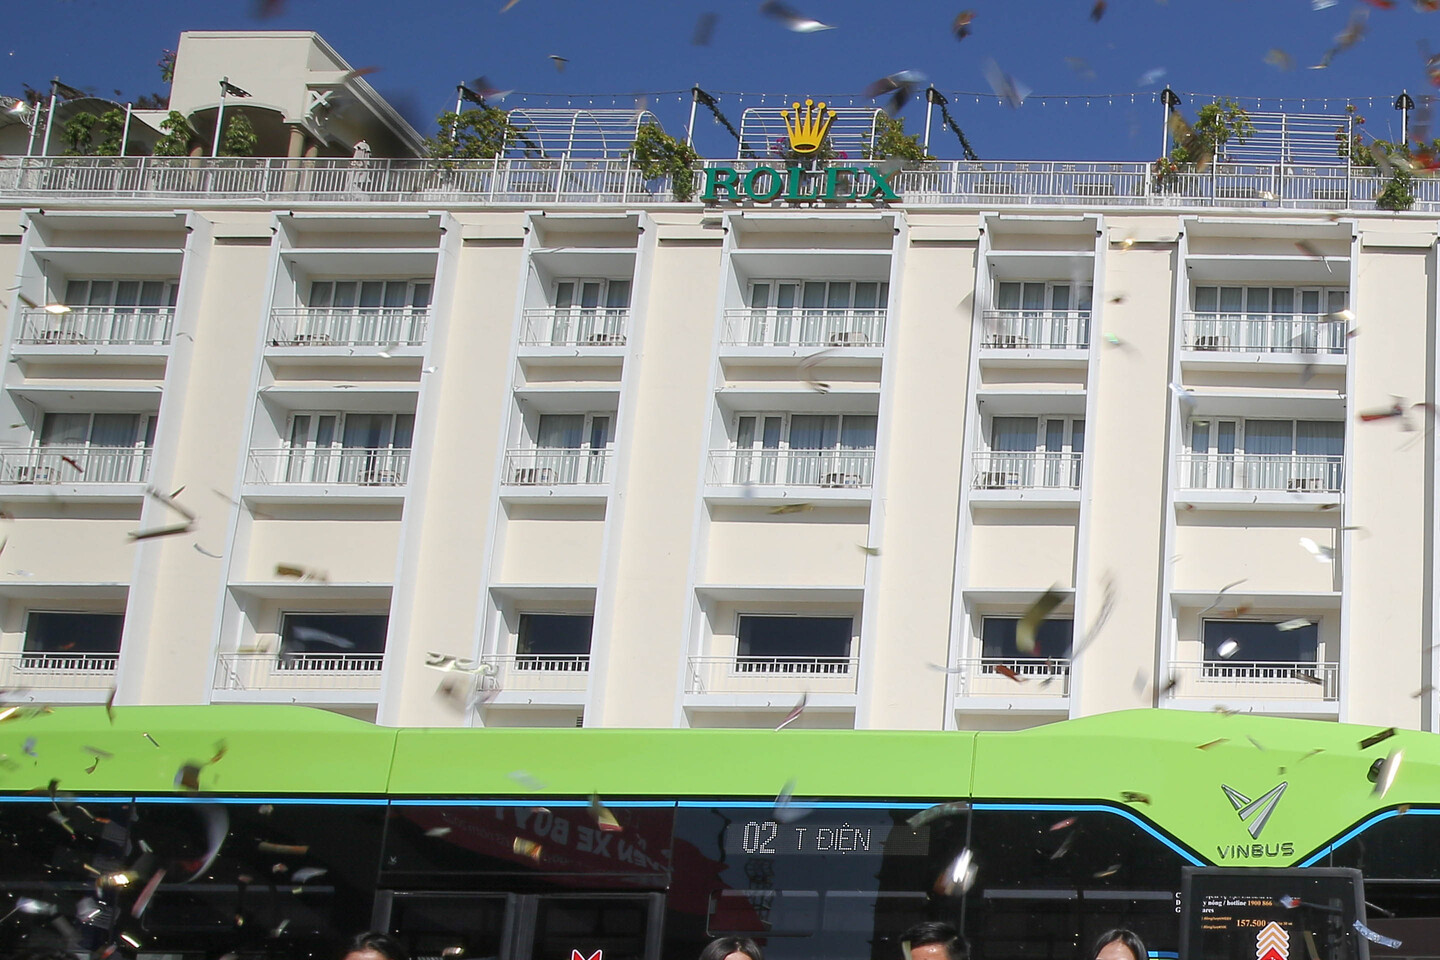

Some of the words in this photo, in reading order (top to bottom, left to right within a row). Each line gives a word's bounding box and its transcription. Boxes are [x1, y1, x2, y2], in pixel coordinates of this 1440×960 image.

[701, 165, 903, 201] ROLEX
[742, 821, 777, 854] 02
[795, 828, 807, 850] T
[816, 822, 871, 854] ĐIỆN
[1217, 842, 1295, 859] VINBUS
